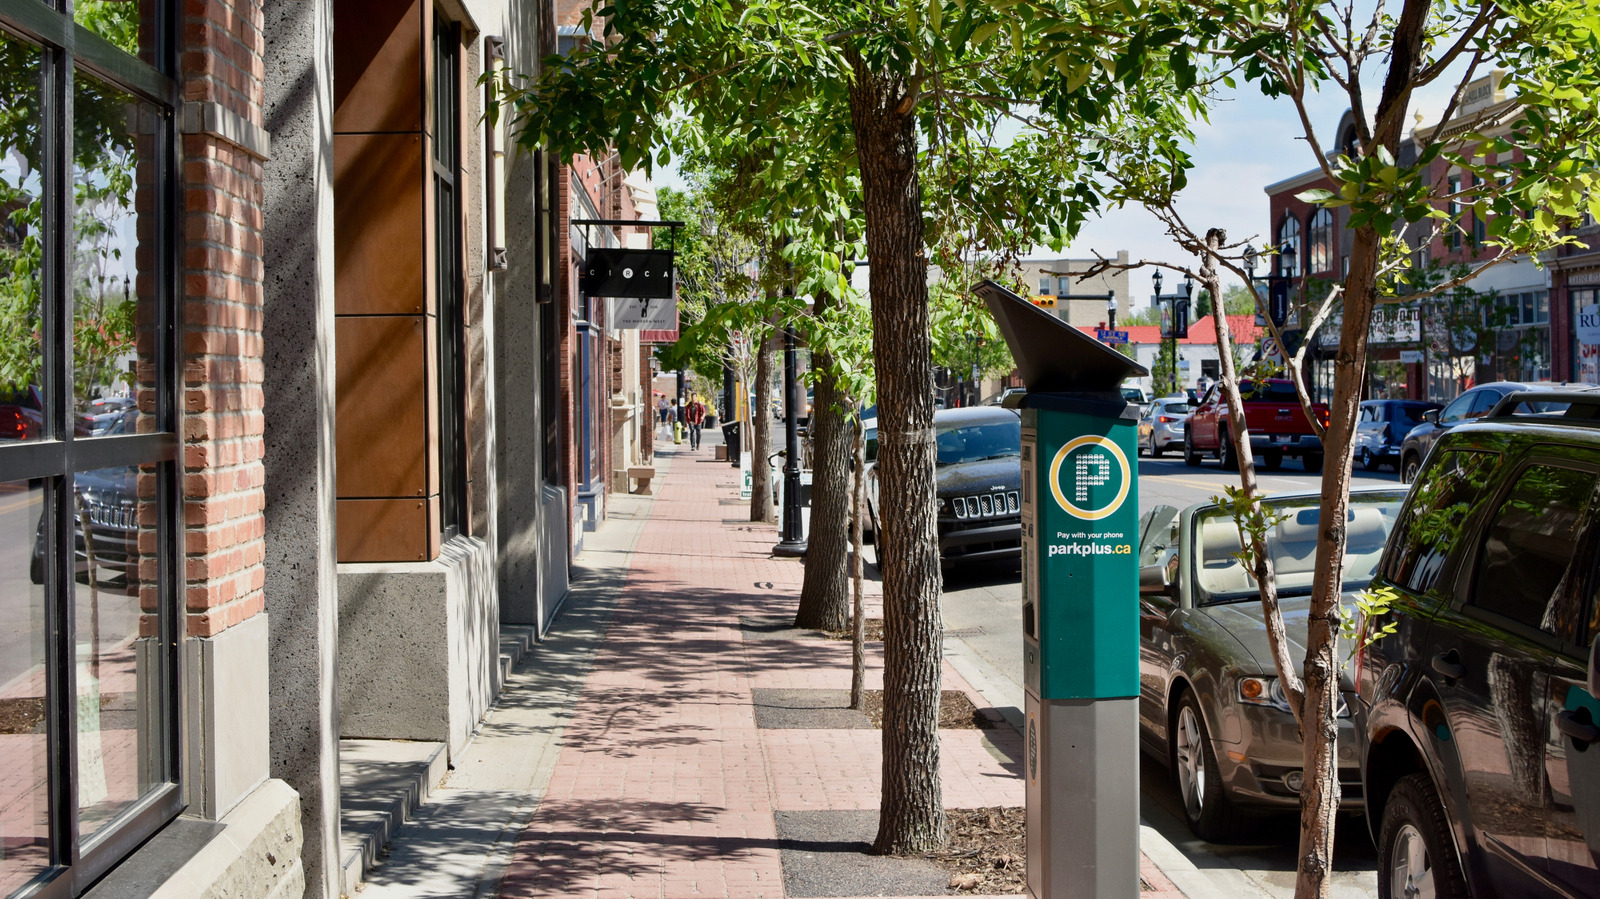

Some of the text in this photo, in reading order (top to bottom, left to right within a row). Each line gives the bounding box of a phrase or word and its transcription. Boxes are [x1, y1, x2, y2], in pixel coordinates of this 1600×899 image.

[589, 268, 669, 278] CIRCA
[1075, 454, 1110, 502] P
[1057, 531, 1070, 539] Pay
[1103, 531, 1124, 539] phone
[1048, 542, 1131, 557] parkplus.ca
